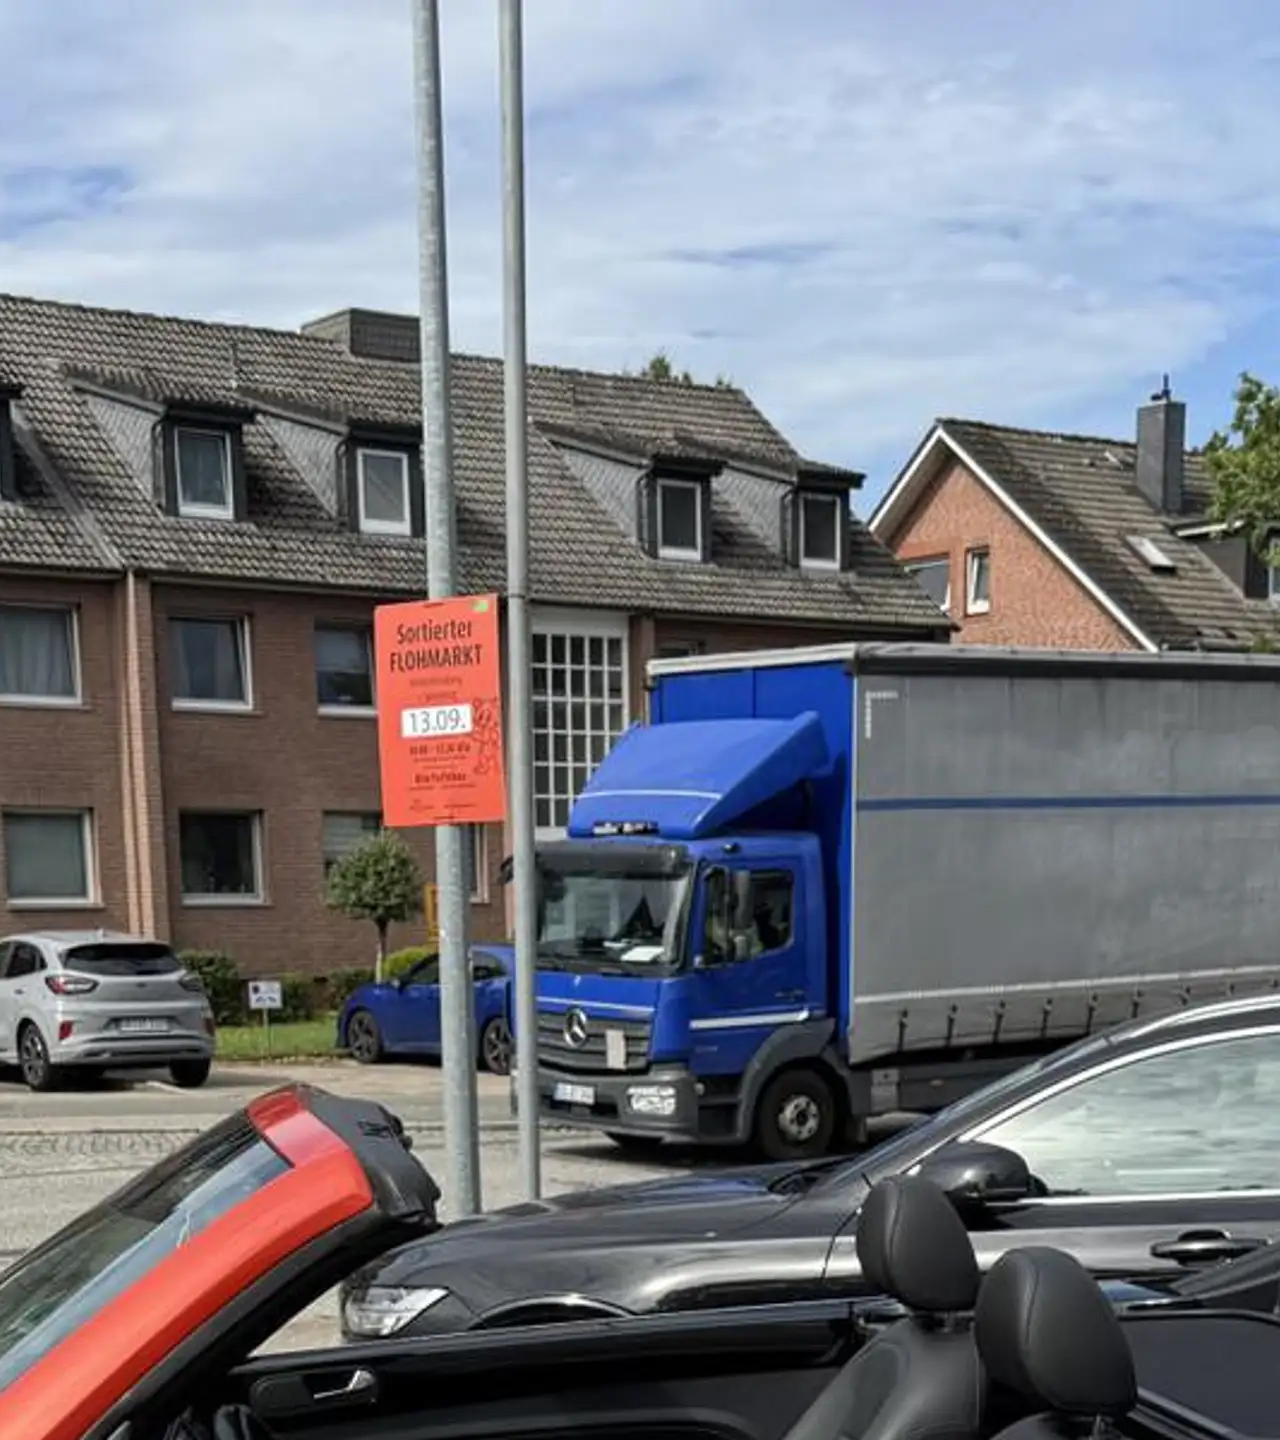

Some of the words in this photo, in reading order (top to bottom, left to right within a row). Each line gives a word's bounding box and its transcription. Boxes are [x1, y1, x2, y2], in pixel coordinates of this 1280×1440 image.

[396, 619, 473, 645] Sortierter
[389, 643, 484, 674] FLOHMARKT
[408, 708, 467, 733] 13.09.
